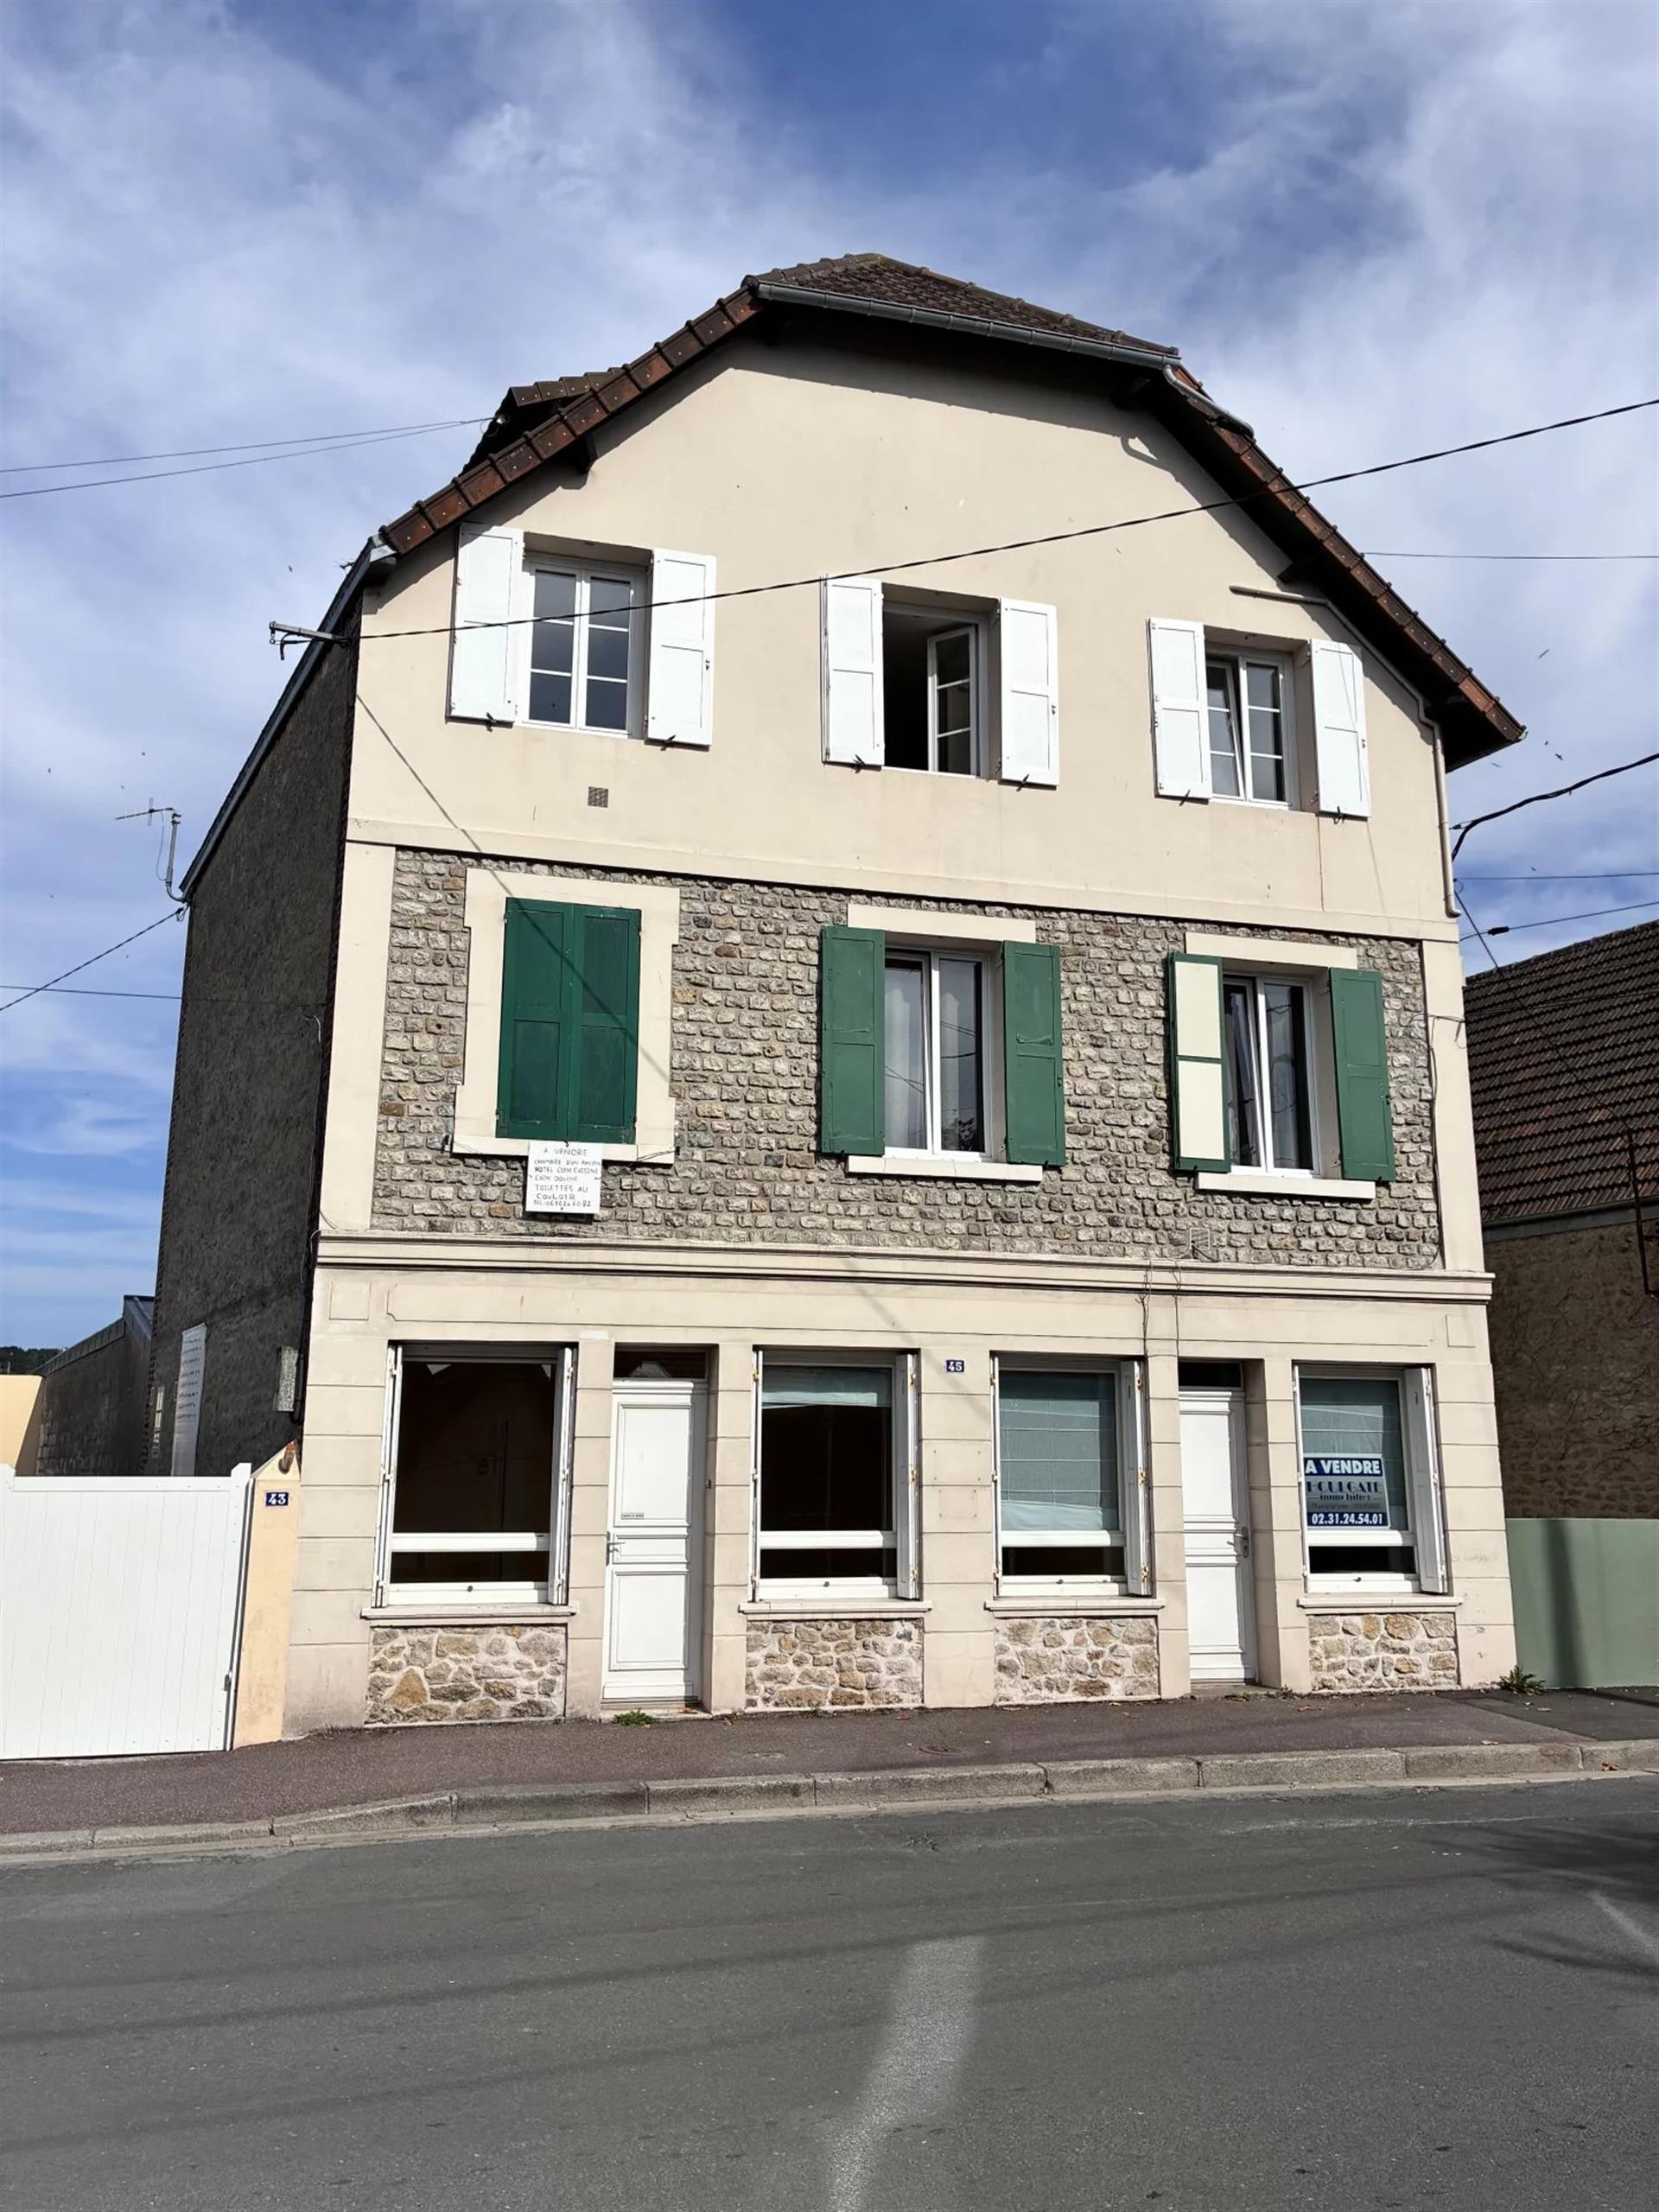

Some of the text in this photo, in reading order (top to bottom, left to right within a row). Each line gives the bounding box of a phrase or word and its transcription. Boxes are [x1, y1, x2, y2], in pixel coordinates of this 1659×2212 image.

[948, 1361, 963, 1372] 45
[1305, 1459, 1381, 1474] A VENDRE
[269, 1493, 286, 1504] 43
[1312, 1513, 1382, 1524] 02.31.24.54.01
